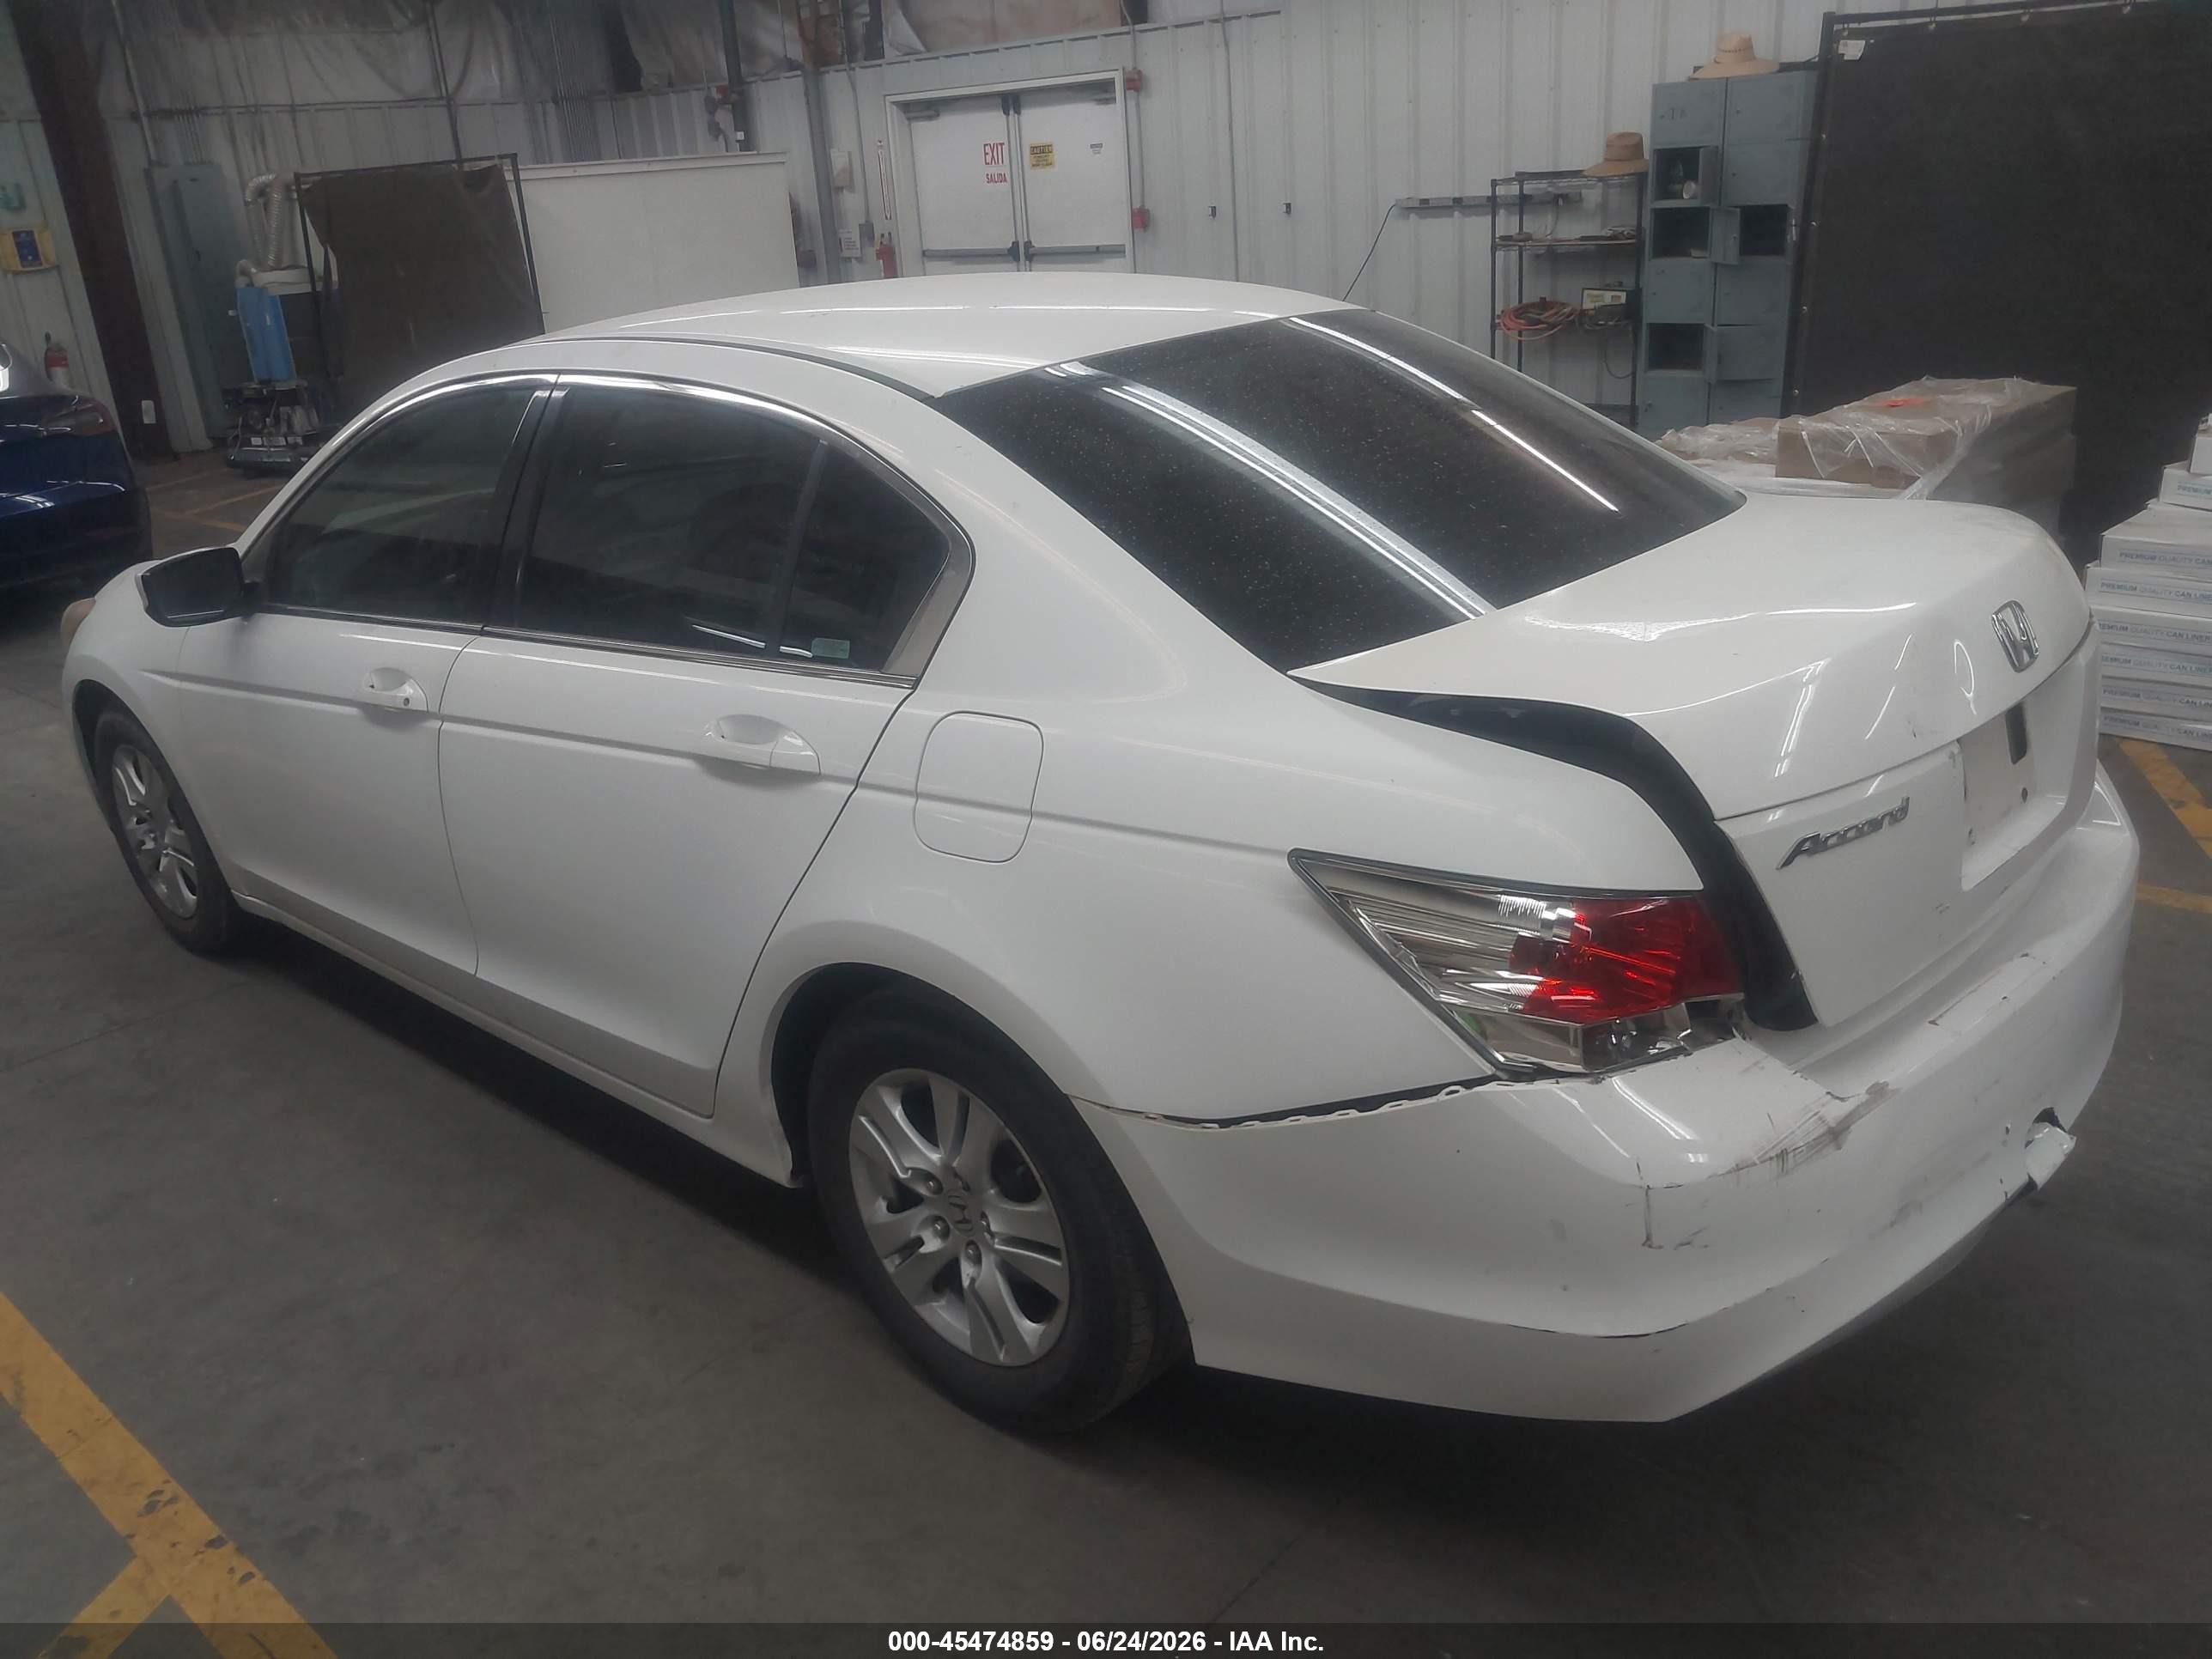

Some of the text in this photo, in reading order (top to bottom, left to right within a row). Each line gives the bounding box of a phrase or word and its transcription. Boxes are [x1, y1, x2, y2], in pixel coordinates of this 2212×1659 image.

[983, 143, 1005, 165] EXIT
[986, 173, 1007, 184] SALIDA
[2118, 552, 2157, 562] PREMIUM
[2100, 582, 2137, 592] PREMIUM
[2174, 590, 2192, 599] CAN
[2166, 630, 2185, 639] CAN
[2170, 664, 2188, 672] CAN
[1776, 797, 1910, 870] Accord
